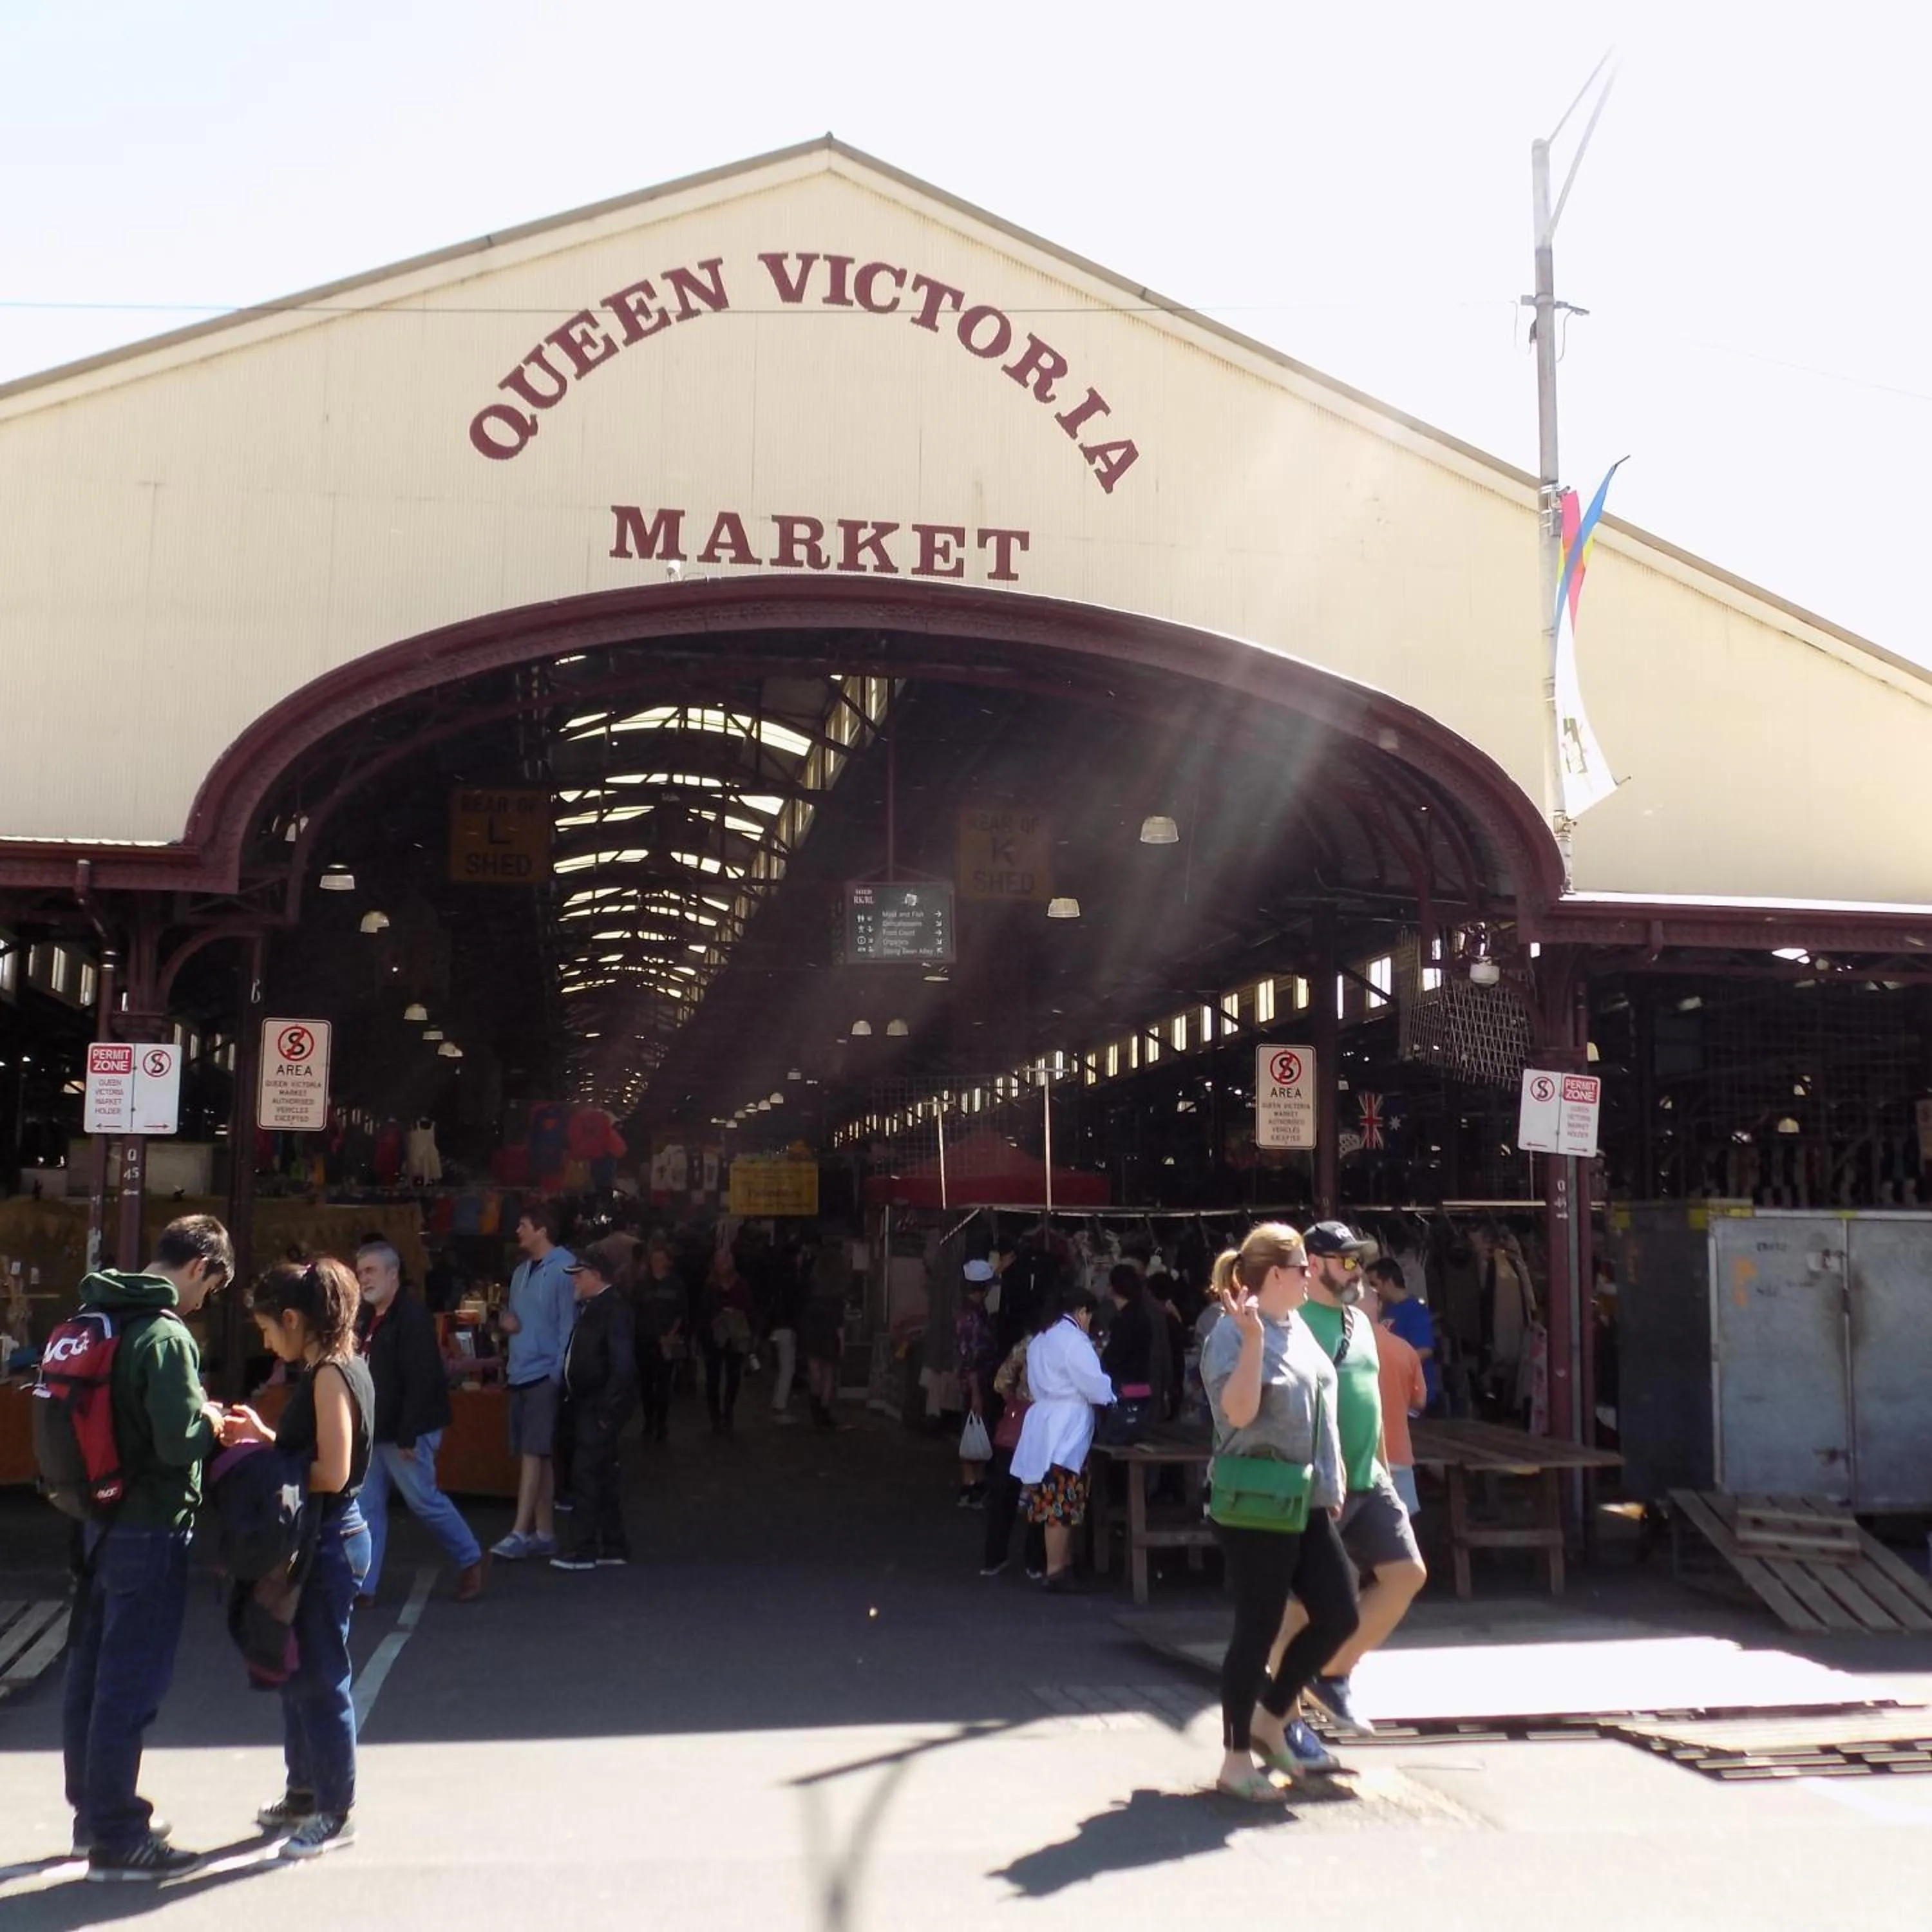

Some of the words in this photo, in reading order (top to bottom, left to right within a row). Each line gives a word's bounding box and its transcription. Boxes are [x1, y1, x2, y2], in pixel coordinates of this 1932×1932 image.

[470, 258, 729, 460] QUEEN
[759, 253, 1139, 493] VICTORIA
[609, 505, 1029, 581] MARKET
[489, 817, 511, 844] L
[992, 838, 1015, 865] K
[466, 852, 533, 876] SHED
[973, 869, 1035, 895] SHED
[92, 1049, 129, 1060] PERMIT
[93, 1061, 129, 1071] ZONE
[276, 1065, 313, 1076] AREA
[1270, 1087, 1302, 1099] AREA
[1566, 1079, 1597, 1091] PERMIT
[1566, 1089, 1595, 1102] ZONE
